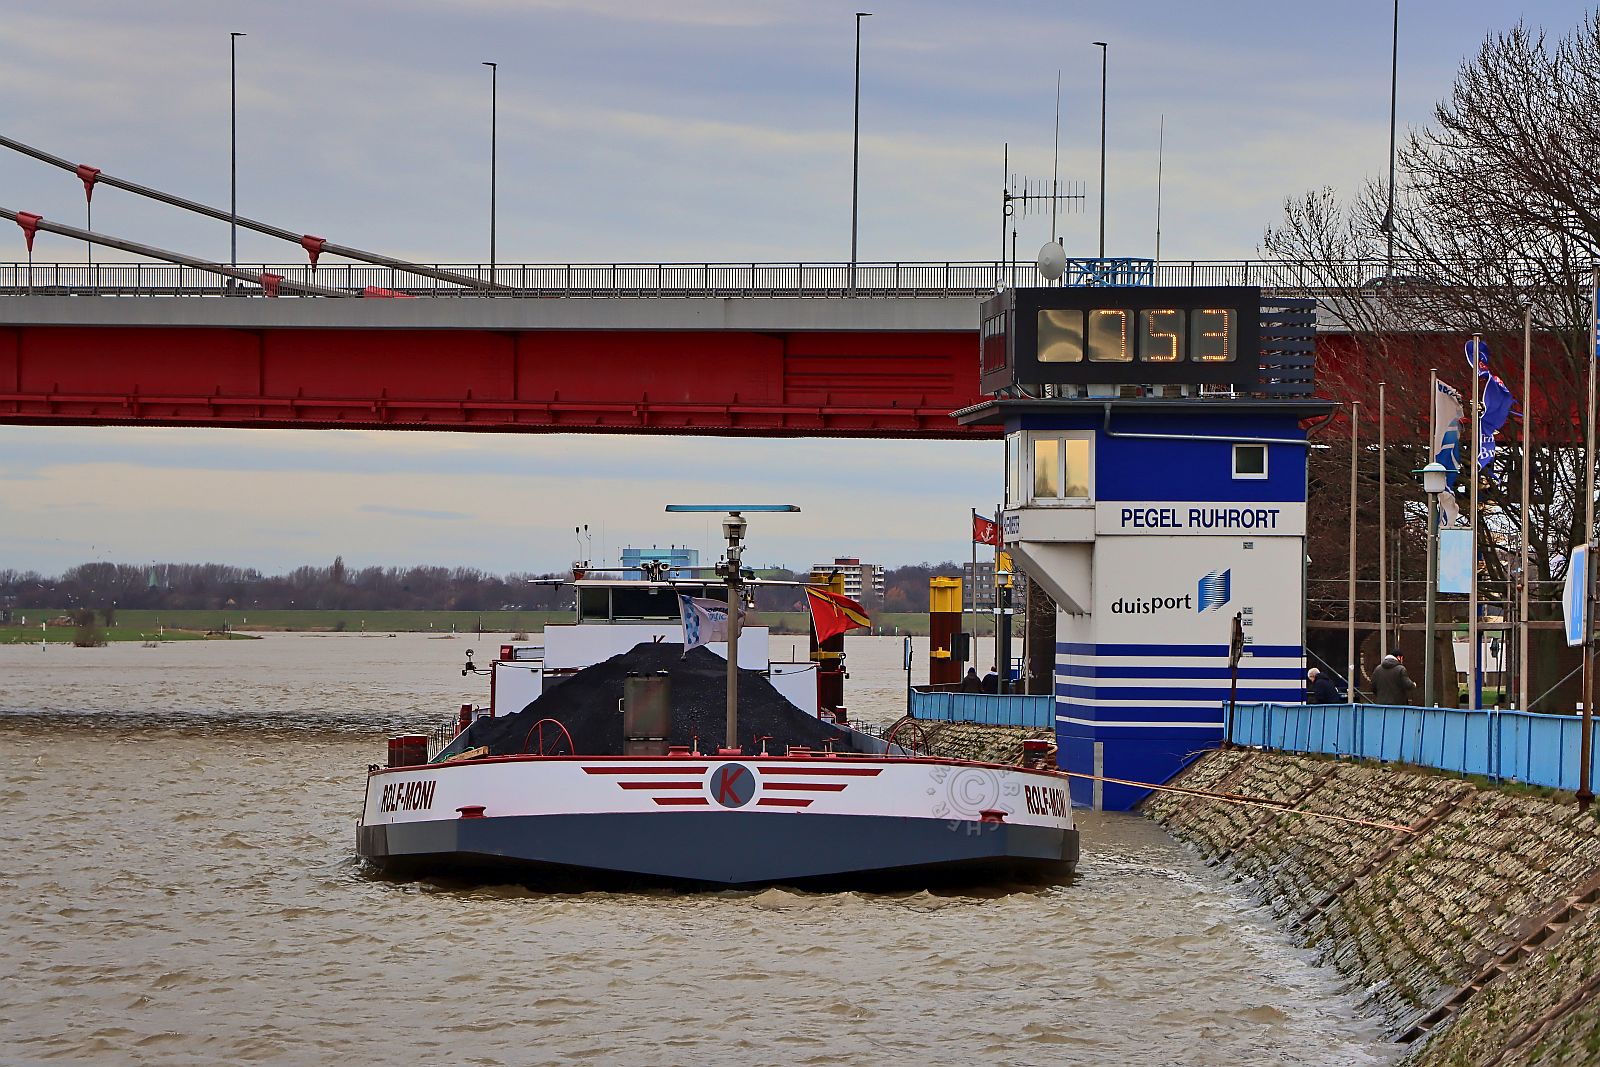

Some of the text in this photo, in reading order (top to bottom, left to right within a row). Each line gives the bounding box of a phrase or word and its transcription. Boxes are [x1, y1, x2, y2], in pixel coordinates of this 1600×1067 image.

[1099, 308, 1229, 361] 753
[1121, 508, 1280, 528] PEGEL RUHRORT
[1111, 593, 1192, 614] duisport
[381, 780, 437, 813] ROLF-MONI
[719, 767, 746, 804] K
